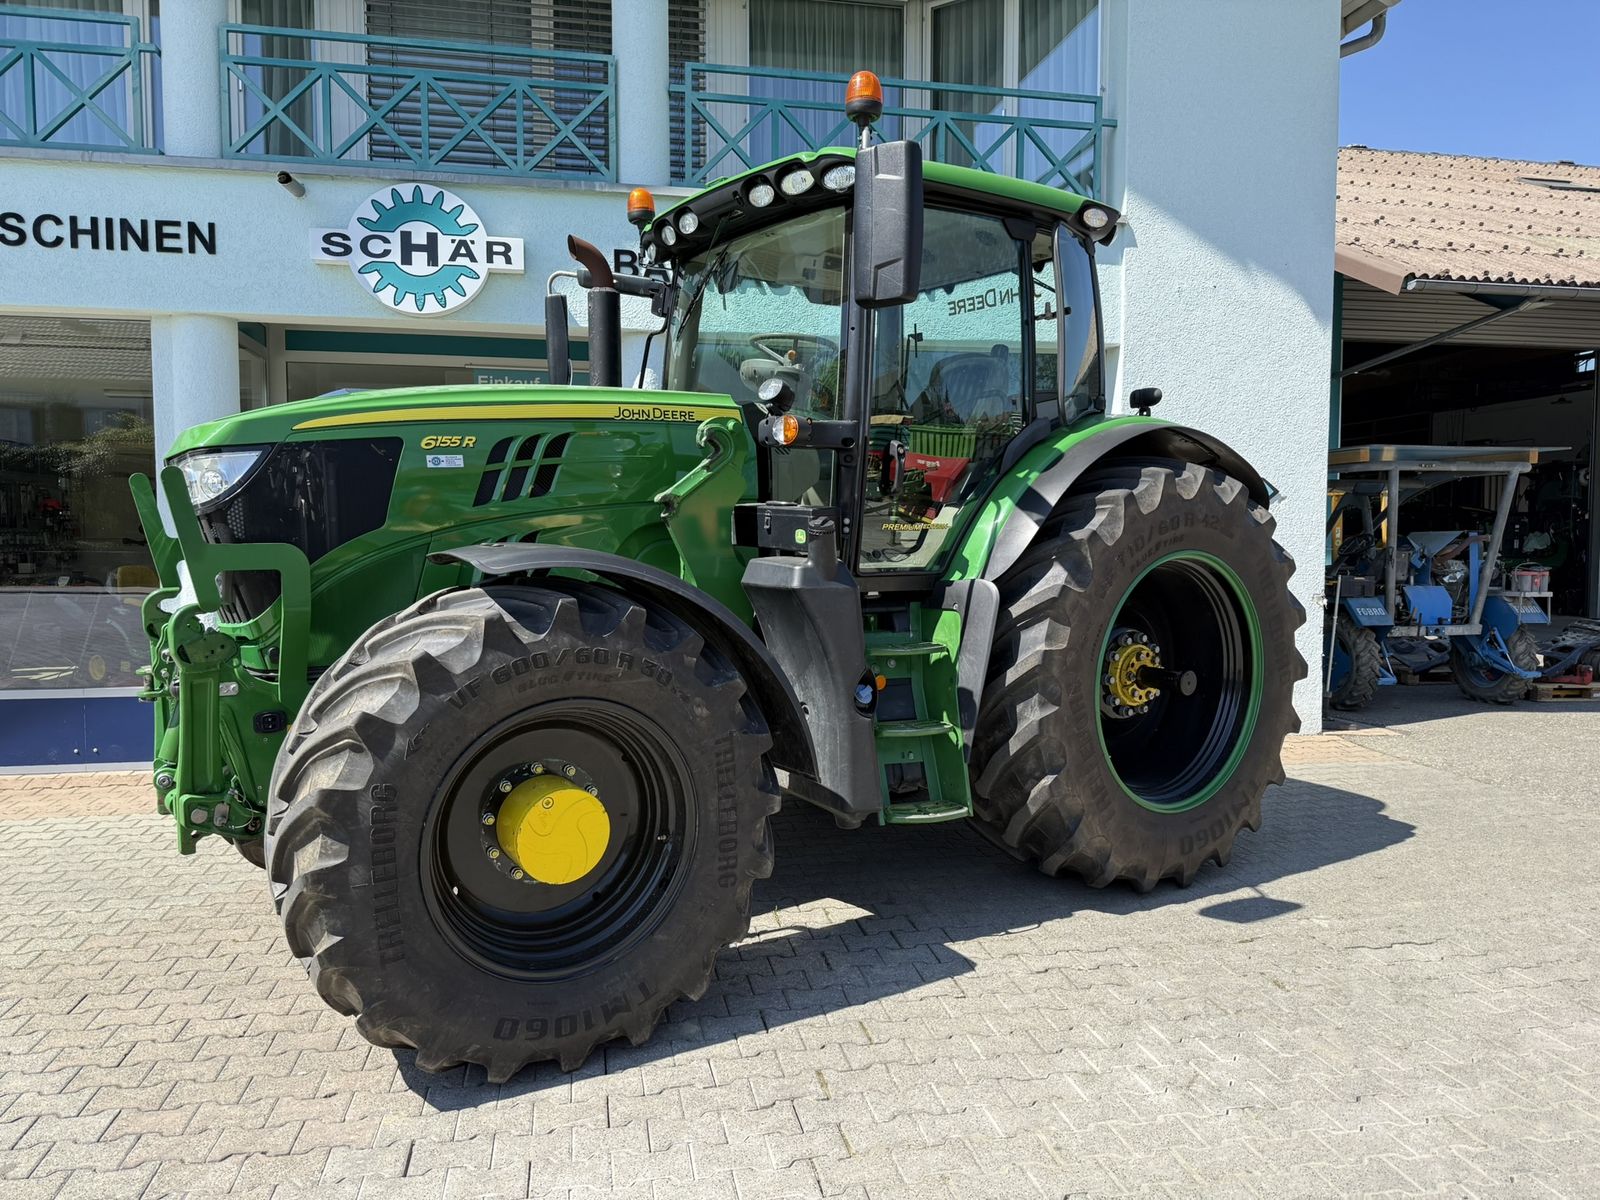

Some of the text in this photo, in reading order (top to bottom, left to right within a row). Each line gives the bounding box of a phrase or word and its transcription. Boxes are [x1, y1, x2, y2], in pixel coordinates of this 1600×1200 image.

[0, 212, 216, 254] SCHINEN
[320, 230, 513, 267] SCHÄR
[614, 406, 695, 420] JOHN DEERE
[881, 523, 922, 531] PREMIUM
[490, 647, 610, 686] 600/60
[369, 783, 406, 968] TRELLEBORG
